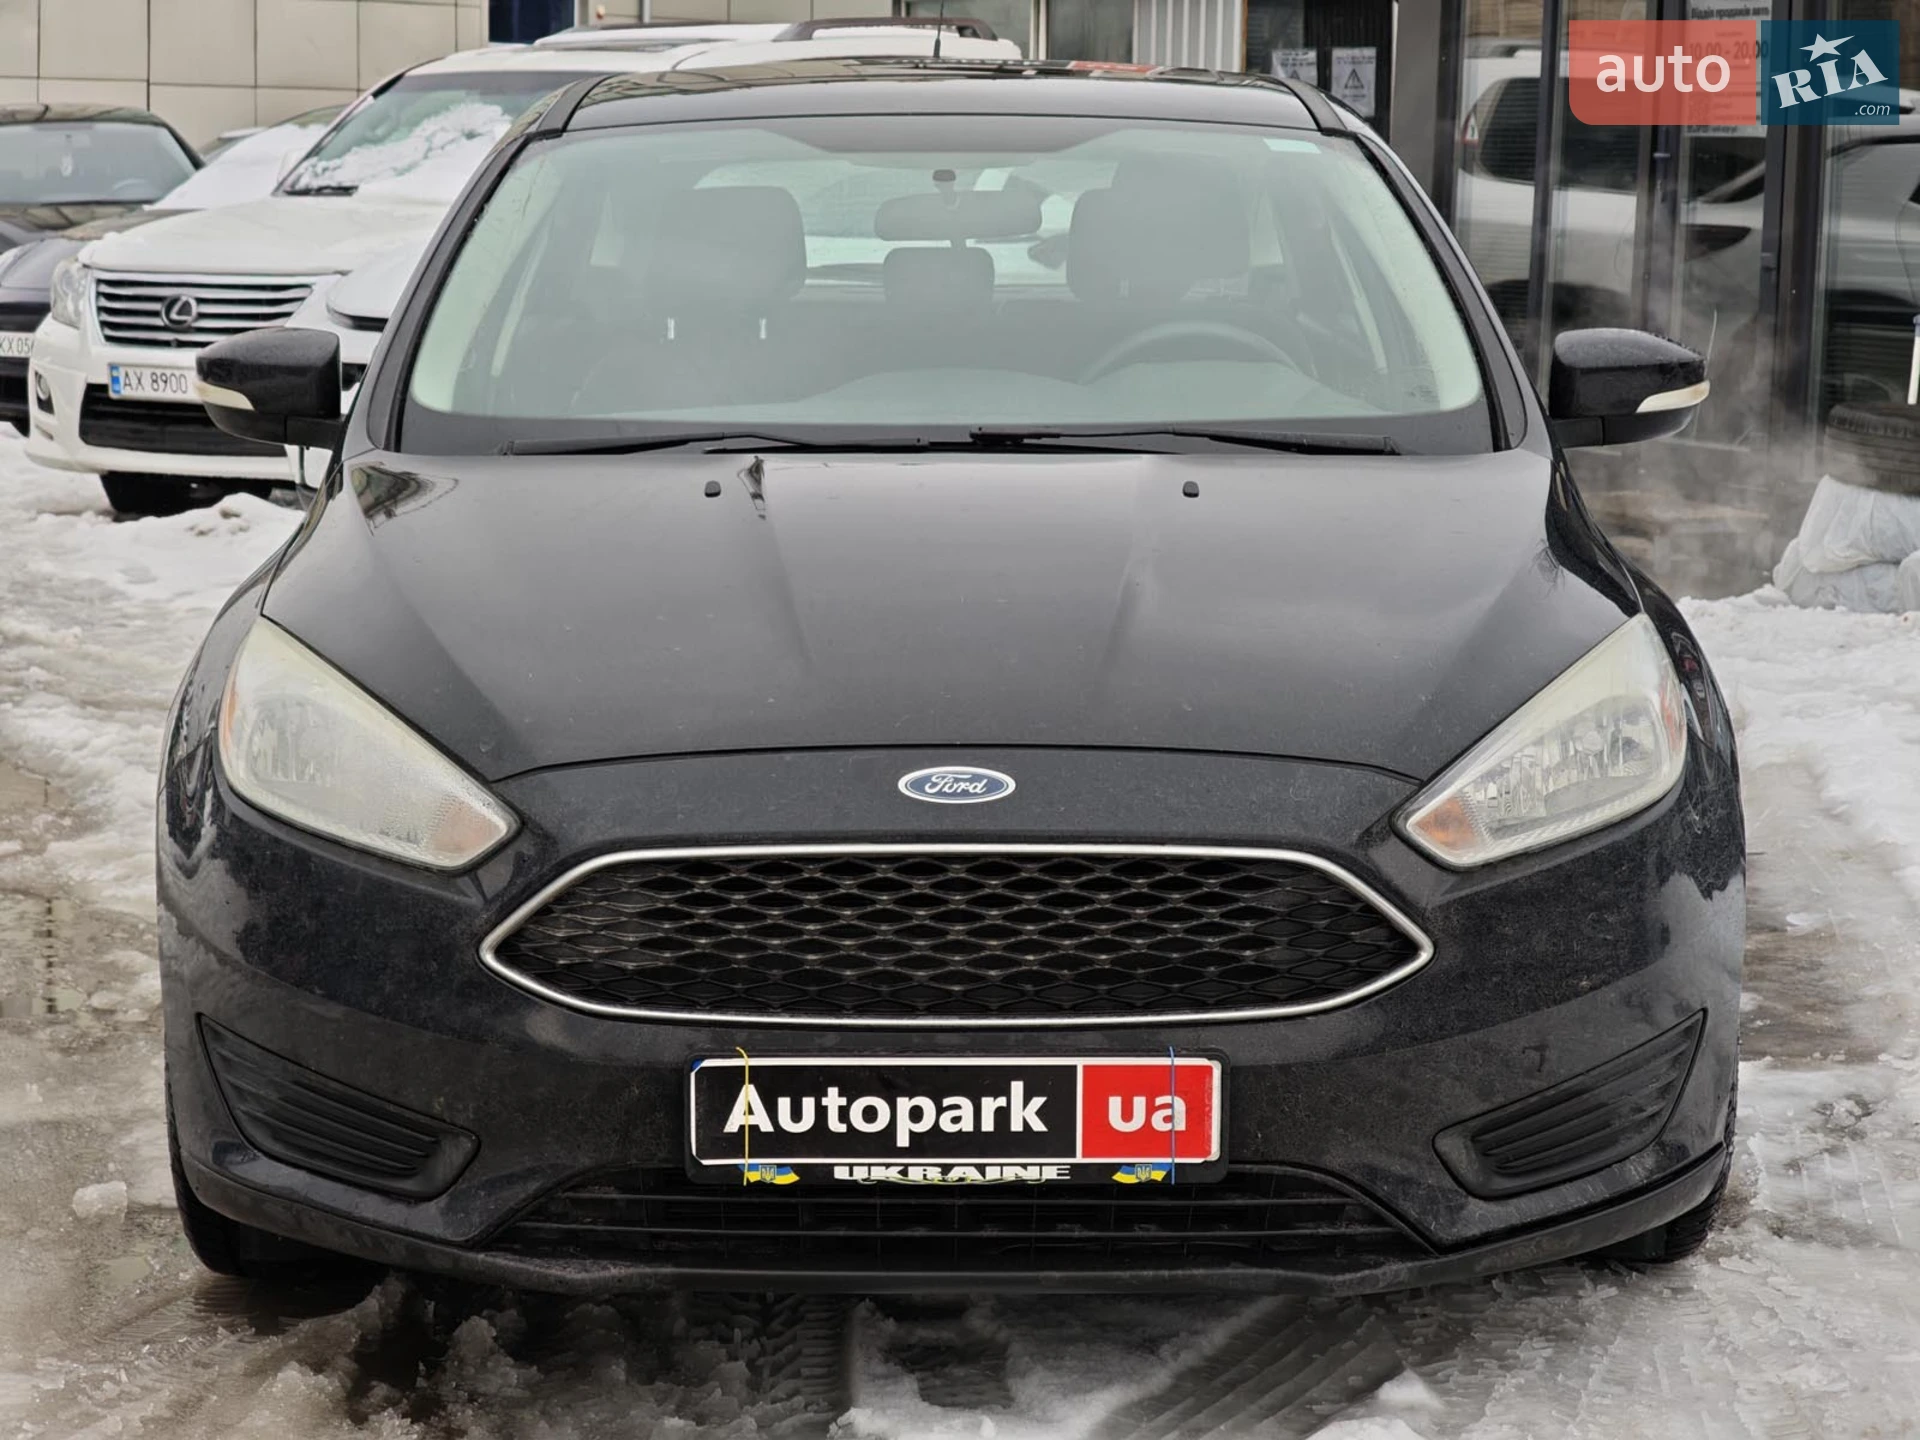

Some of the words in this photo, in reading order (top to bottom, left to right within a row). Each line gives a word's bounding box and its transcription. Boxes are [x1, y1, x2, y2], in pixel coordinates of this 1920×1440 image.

[123, 370, 145, 391] AX
[150, 372, 188, 394] 8900
[924, 773, 988, 794] Ford
[723, 1080, 1049, 1148] Autopark
[1107, 1094, 1187, 1133] ua
[833, 1165, 1071, 1180] UKRAINE
